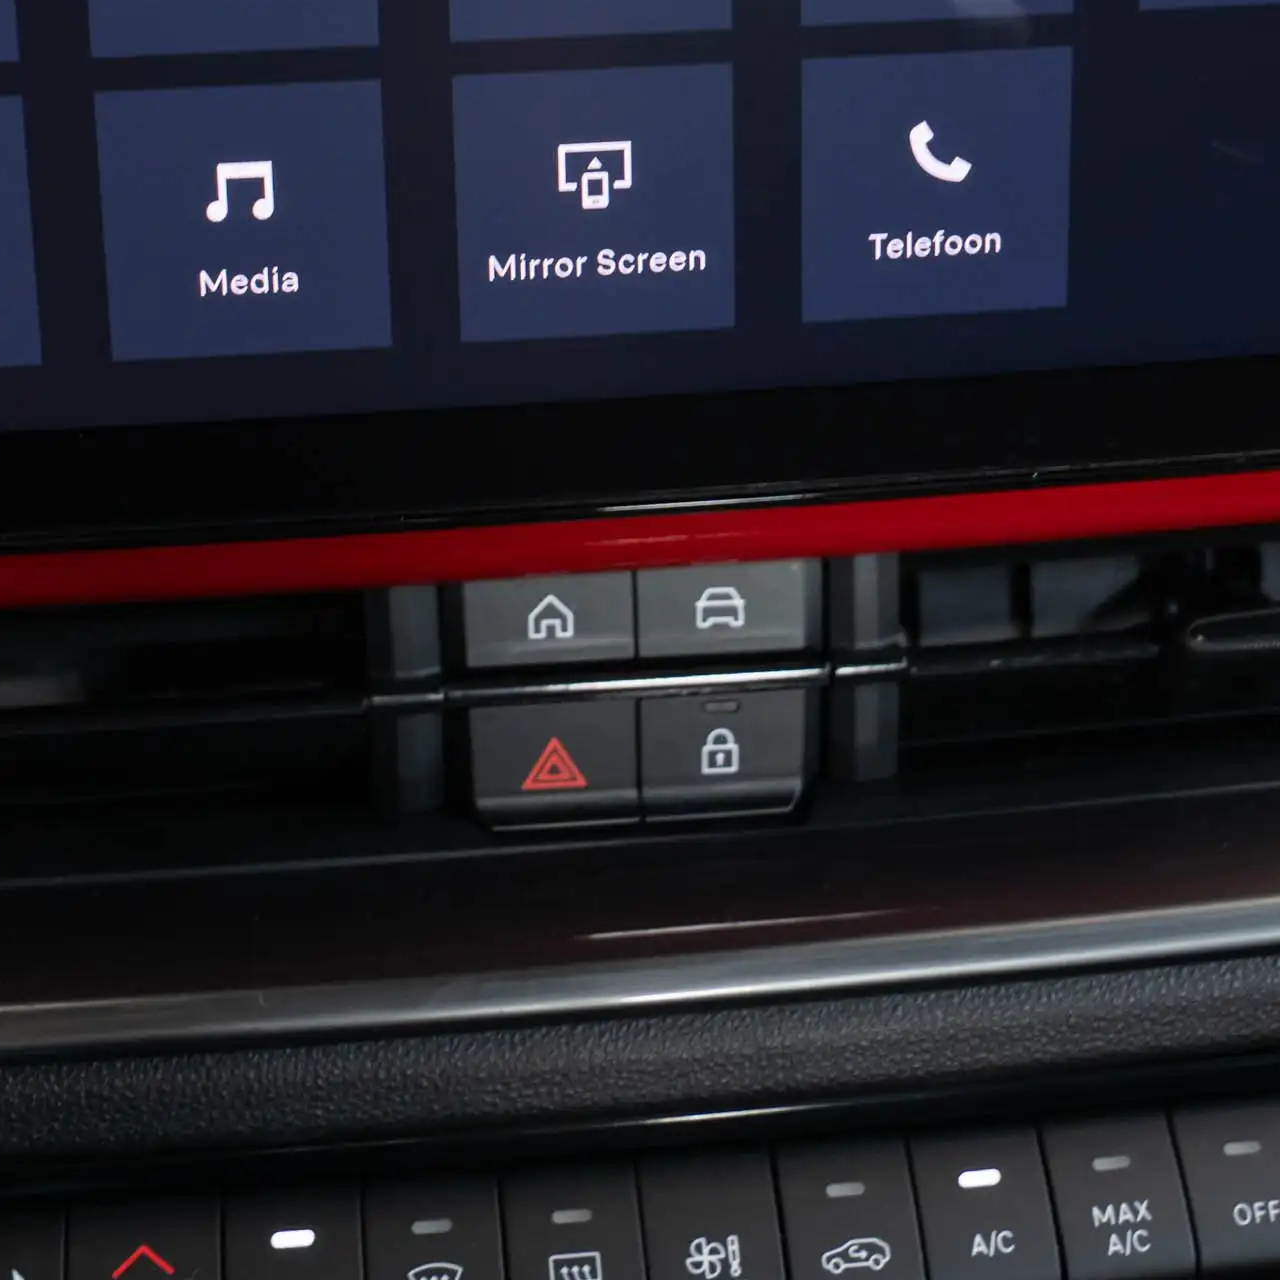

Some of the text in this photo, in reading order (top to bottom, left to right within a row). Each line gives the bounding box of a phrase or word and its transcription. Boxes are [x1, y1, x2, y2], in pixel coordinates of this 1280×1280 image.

[869, 230, 1002, 261] Telefoon
[488, 249, 706, 282] Mirror Screen
[200, 266, 299, 297] Media
[1091, 1199, 1152, 1228] MAX
[1233, 1200, 1280, 1225] OFF
[971, 1230, 1015, 1257] A/C
[1107, 1228, 1151, 1257] A/C
